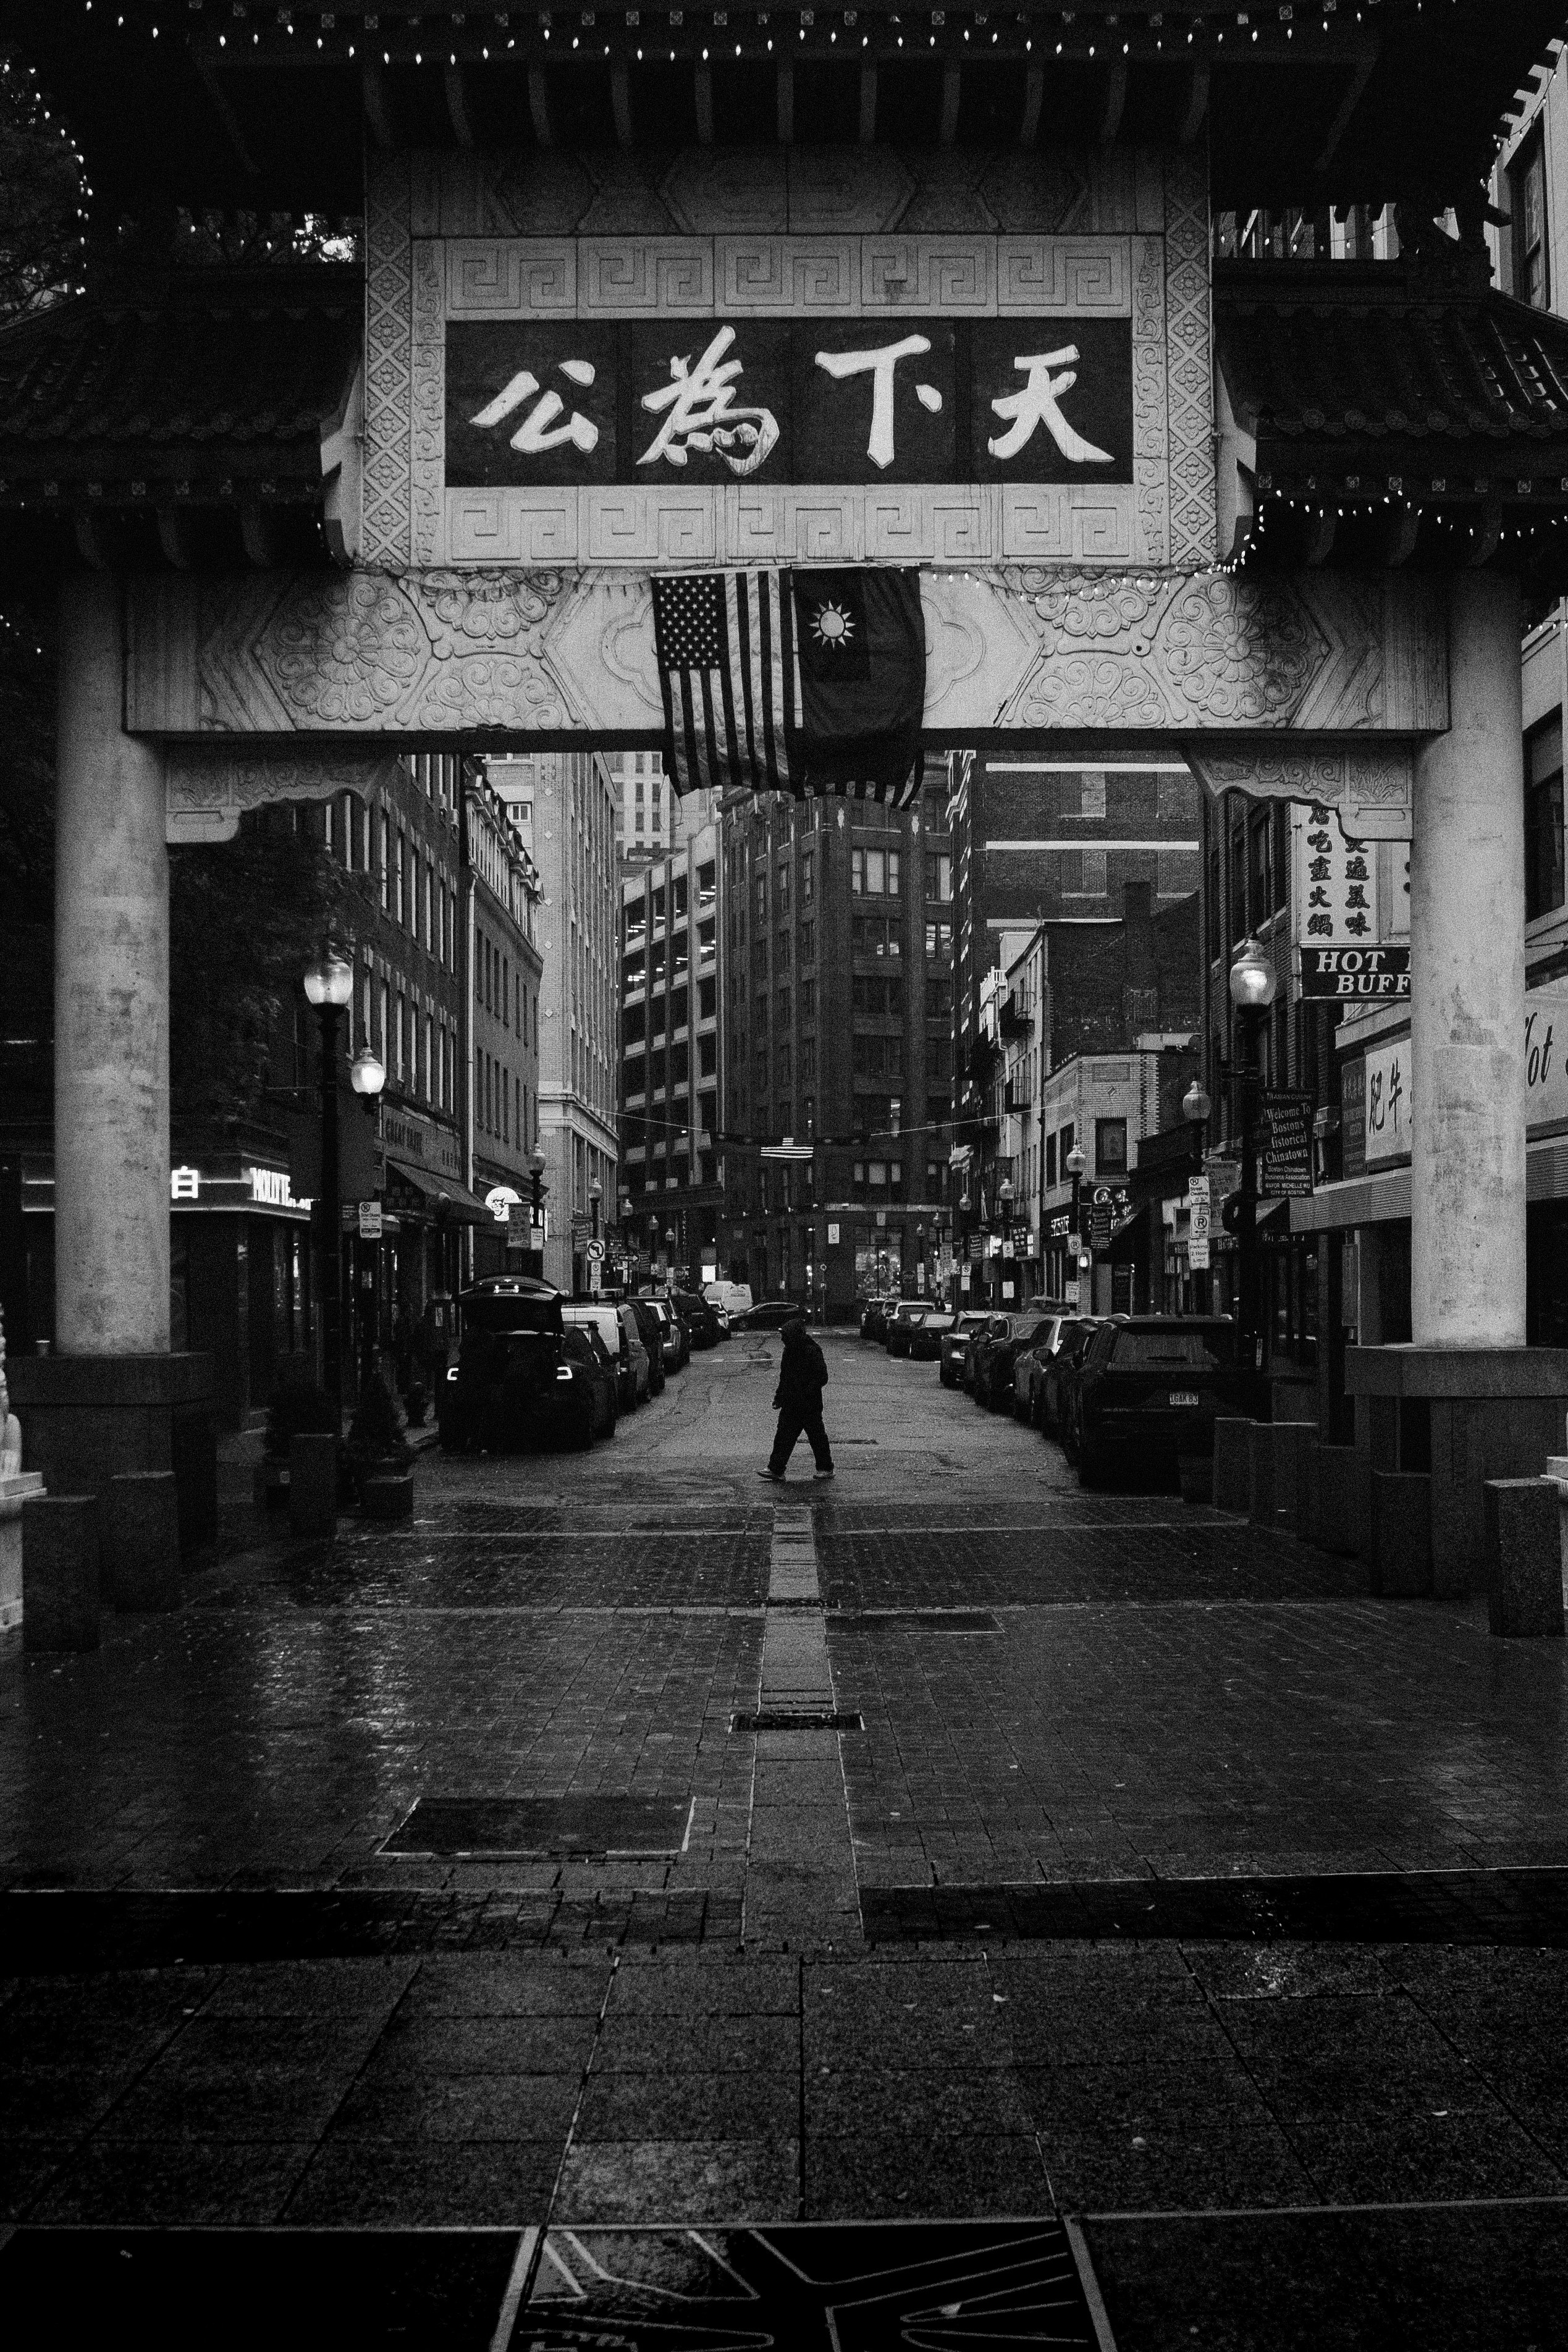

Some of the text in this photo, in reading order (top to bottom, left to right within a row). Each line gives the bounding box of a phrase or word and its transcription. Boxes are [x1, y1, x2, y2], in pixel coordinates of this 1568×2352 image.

[1316, 951, 1386, 972] HOT
[1368, 1056, 1412, 1135] 肥牛
[1263, 1103, 1310, 1120] Welcome To
[1266, 1149, 1308, 1164] Chinatown
